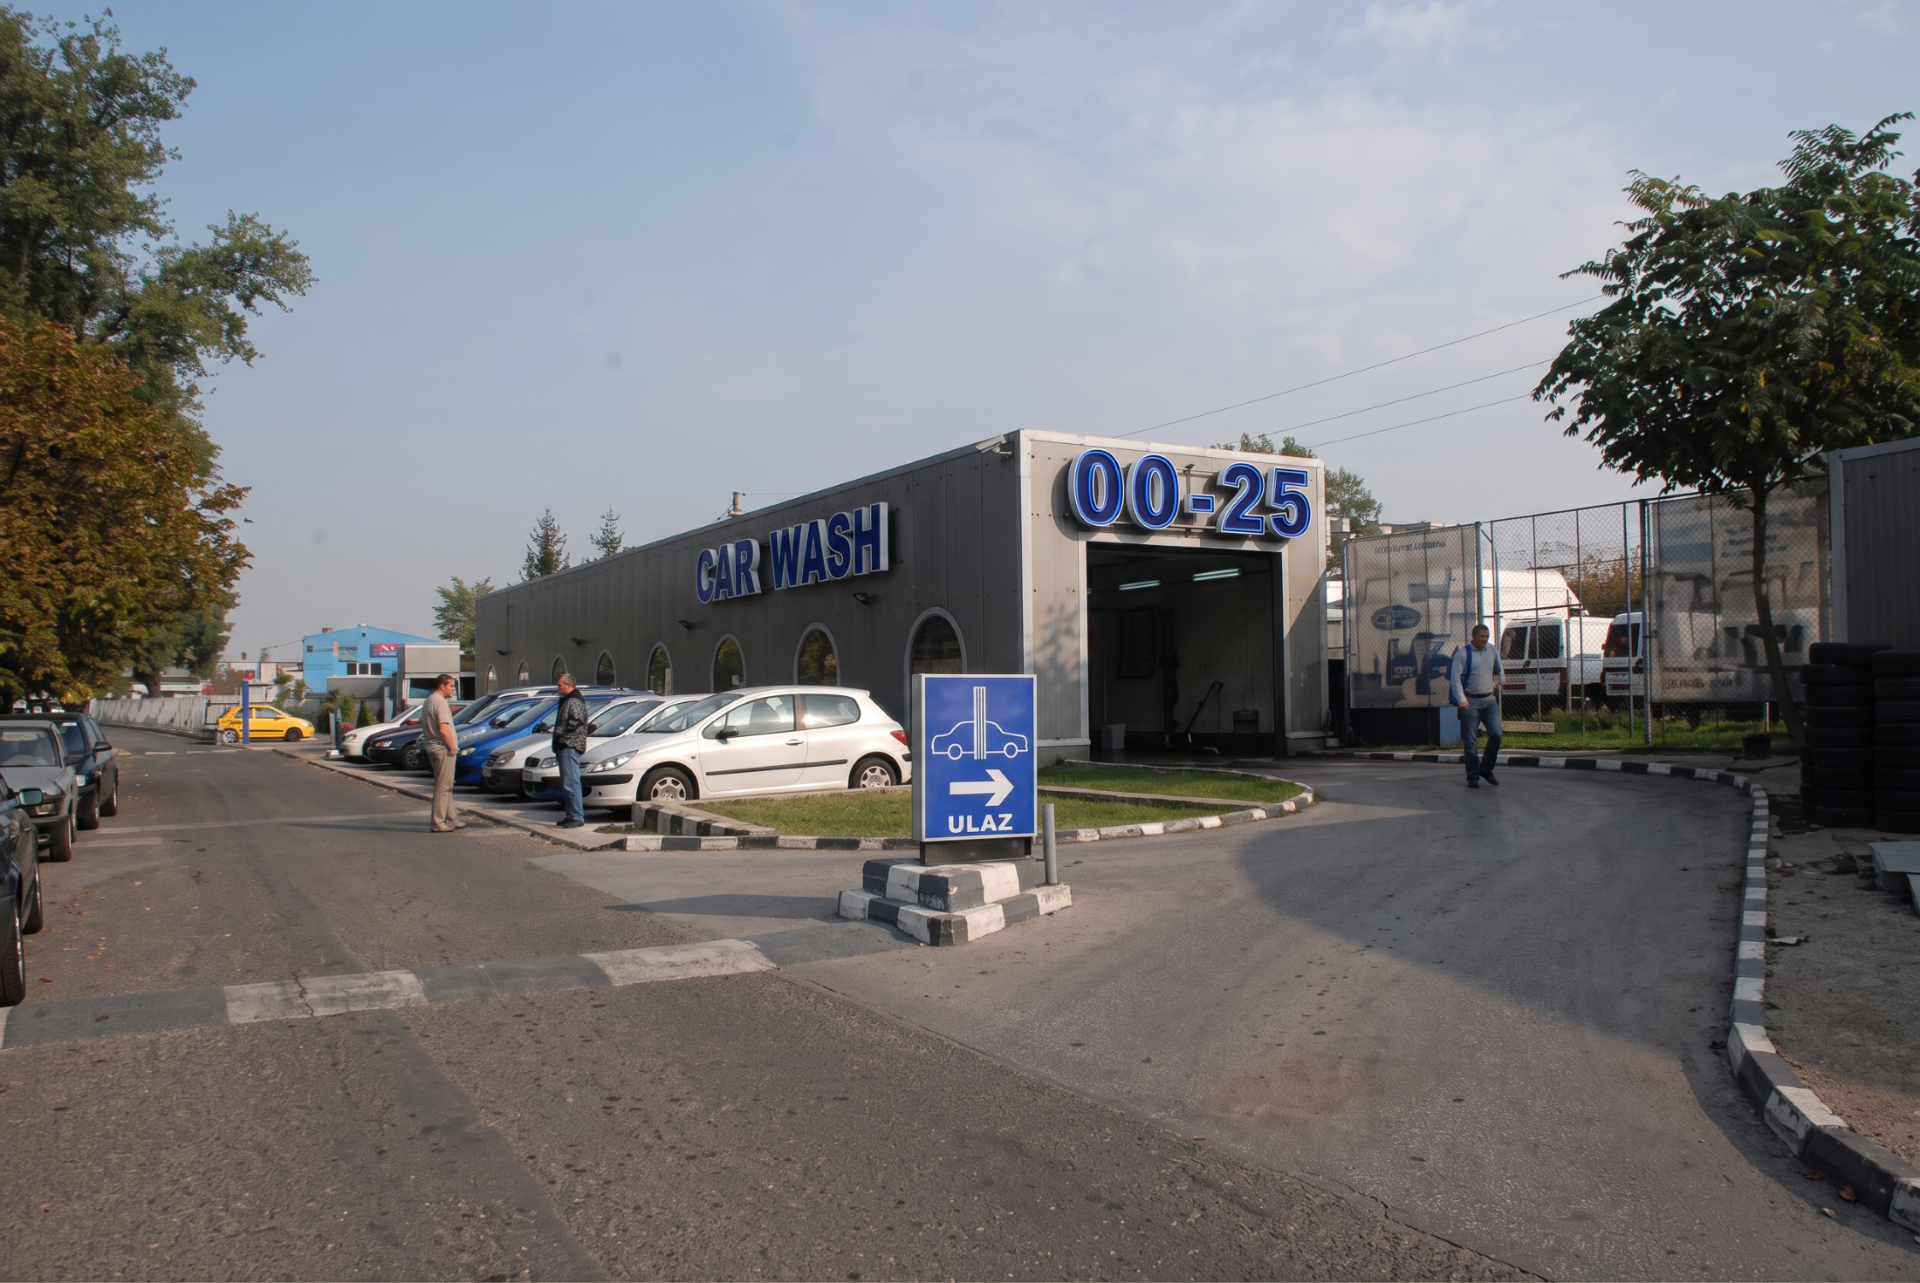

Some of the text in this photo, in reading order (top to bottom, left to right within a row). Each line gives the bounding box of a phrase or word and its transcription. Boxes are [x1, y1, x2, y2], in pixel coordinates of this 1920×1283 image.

[1068, 449, 1312, 539] 00-25
[696, 502, 889, 604] CAR WASH
[948, 813, 1013, 834] ULAZ
